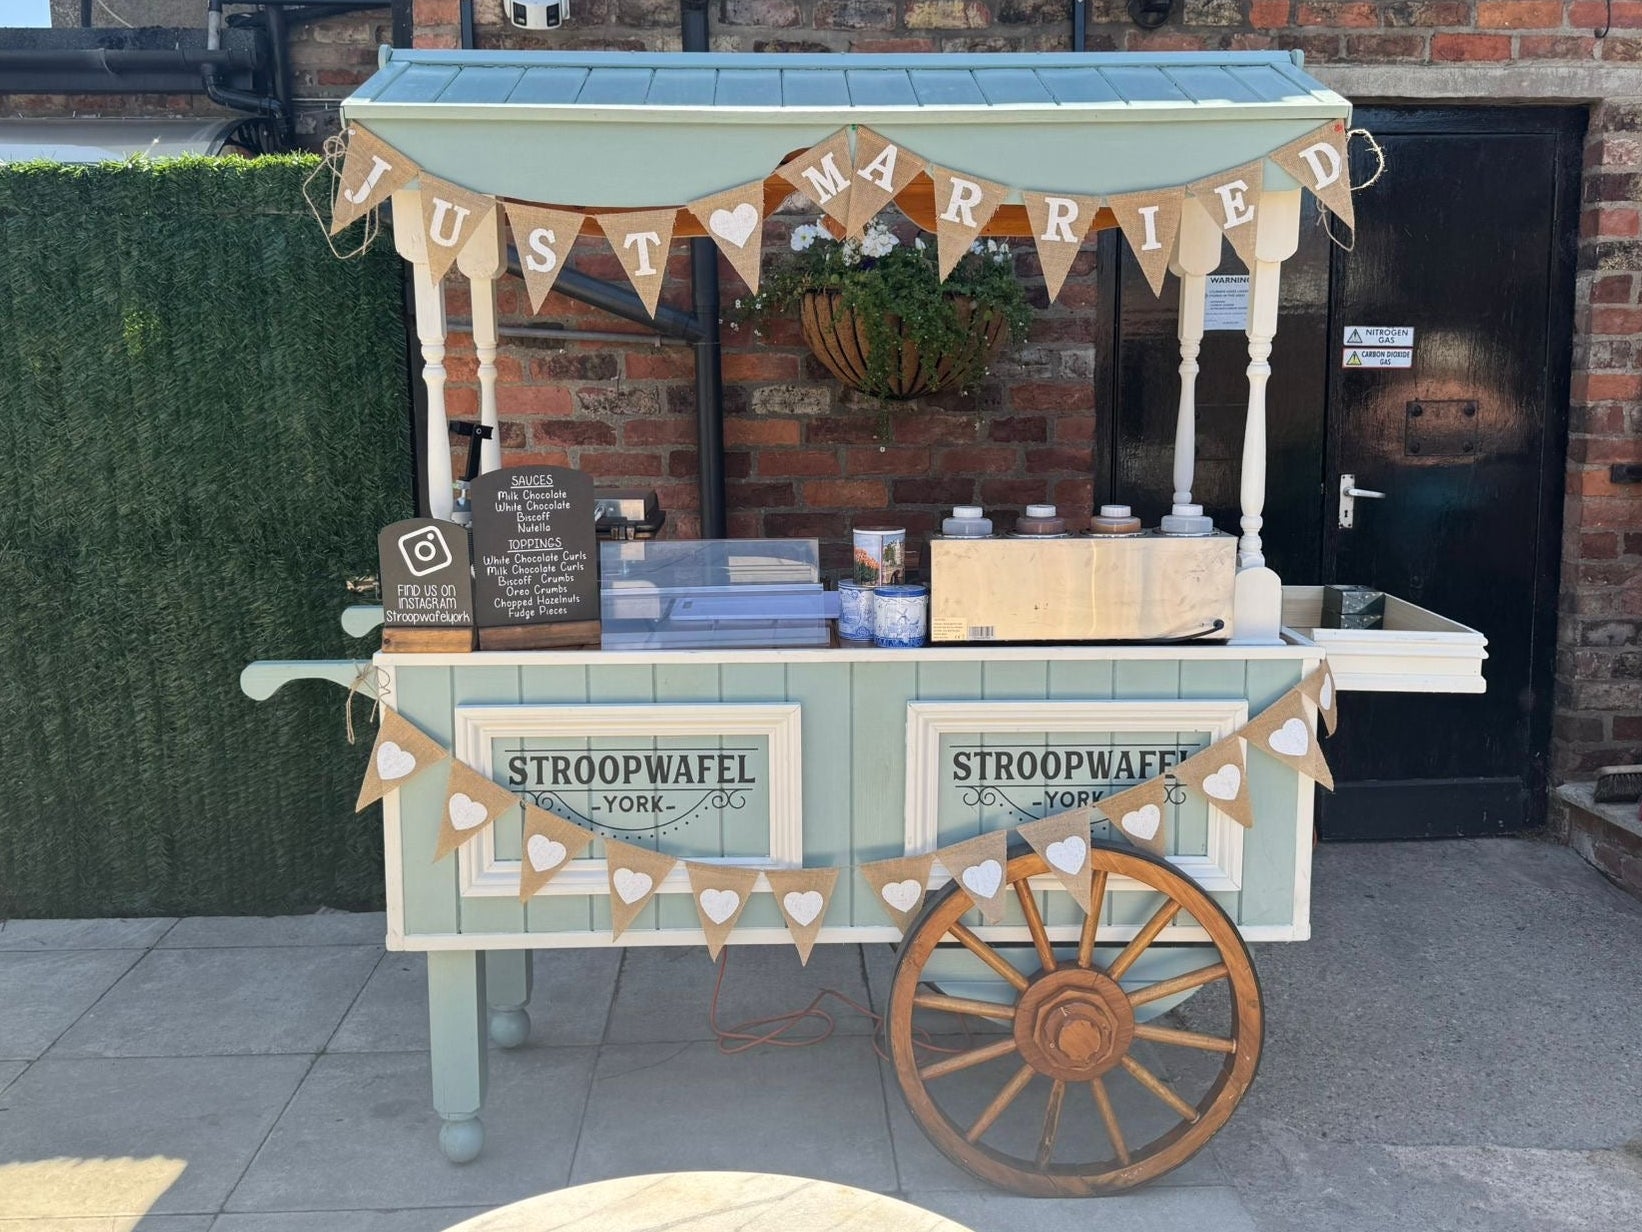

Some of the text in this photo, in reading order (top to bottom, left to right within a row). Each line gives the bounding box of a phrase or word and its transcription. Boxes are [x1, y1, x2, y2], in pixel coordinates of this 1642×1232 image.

[344, 142, 1342, 276] JUST MARRIED
[511, 474, 553, 486] SAUCES
[497, 489, 567, 501] Milk Chocolate
[495, 500, 571, 512] White Chocolate
[516, 511, 551, 522] Biscoff
[517, 523, 551, 533] Nutella
[508, 537, 562, 550] TOPPINGS
[482, 550, 587, 565] White Chocolate Curls
[487, 561, 585, 576] Milk Chocolate Curls
[498, 573, 575, 586] Biscoff Crumbs
[397, 584, 456, 596] FIND US ON
[506, 584, 568, 597] Oreo Crumbs
[398, 597, 457, 609] INSTAGRAM
[494, 594, 581, 609] Chopped Hazelnuts
[386, 610, 471, 625] Stroopwafelyork
[508, 605, 568, 620] Fudge Pieces
[508, 755, 756, 786] STROOPWAFEL
[953, 750, 1189, 781] STROOPWAFE
